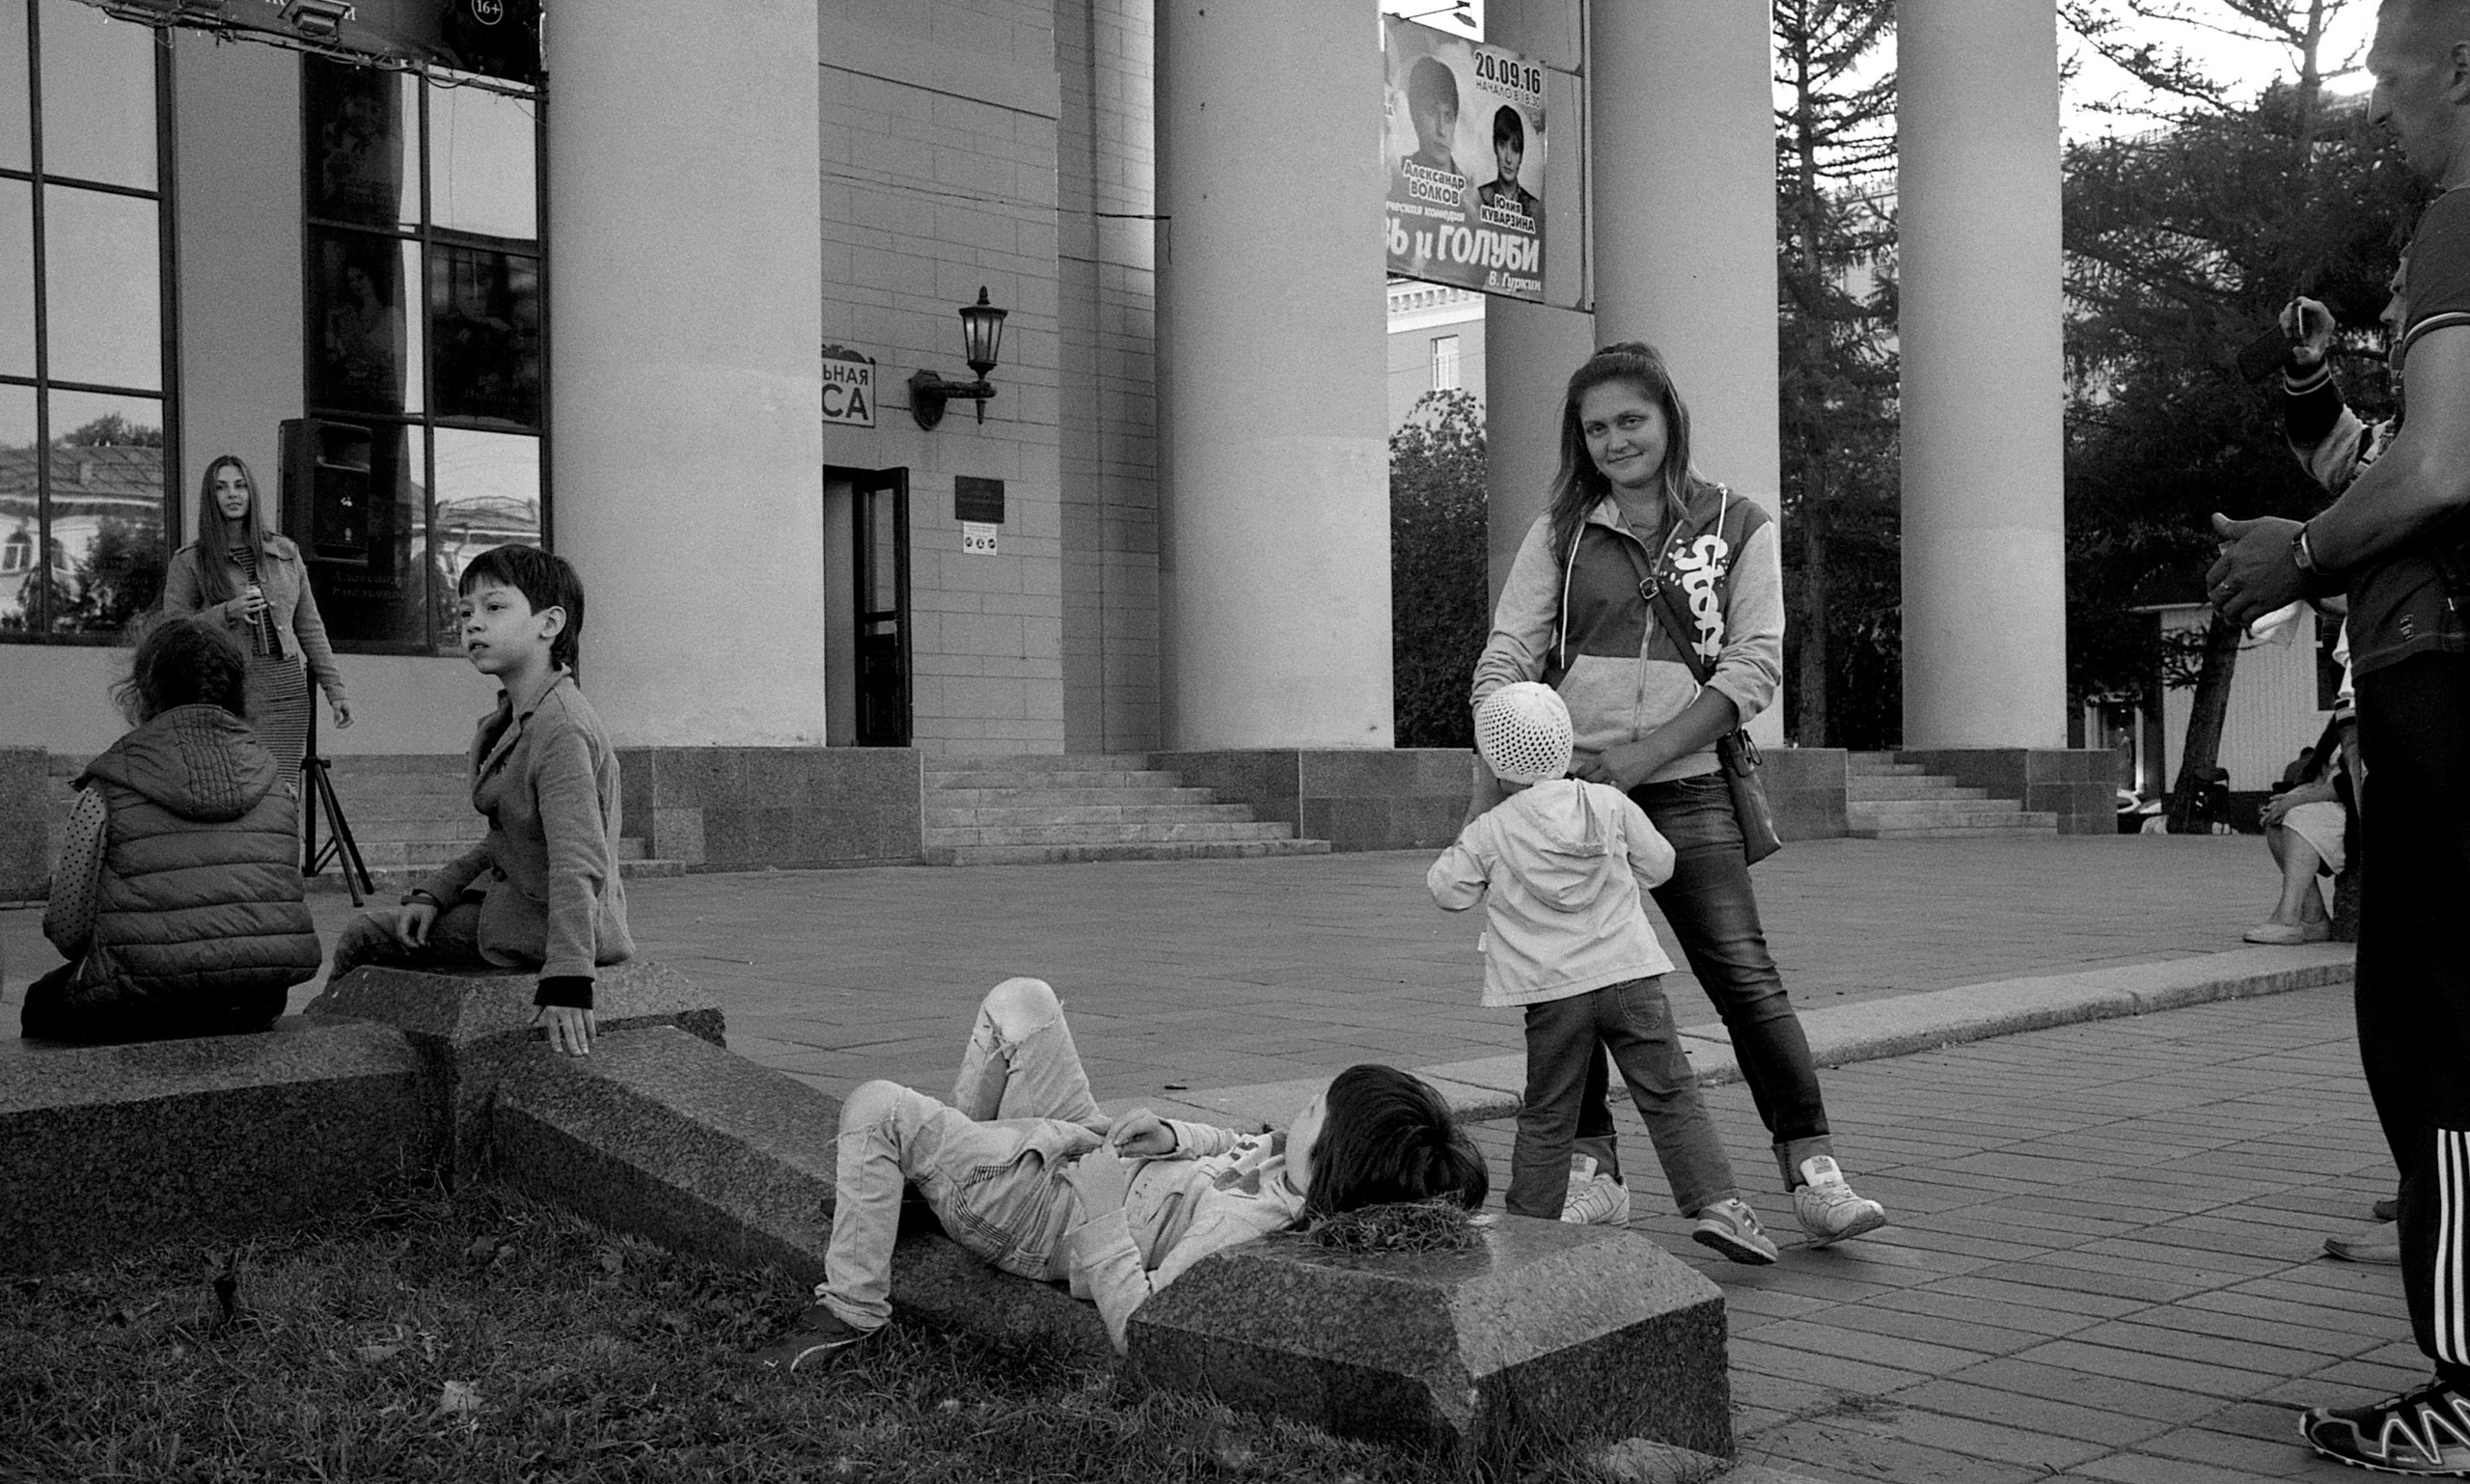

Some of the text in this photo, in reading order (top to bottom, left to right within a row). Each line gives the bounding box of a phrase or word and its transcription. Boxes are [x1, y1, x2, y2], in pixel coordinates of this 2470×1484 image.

[477, 0, 501, 14] 16+
[1475, 51, 1541, 95] 20.09.16
[1475, 80, 1512, 98] НАЧАЛО
[1411, 180, 1460, 206] ВОЛКОВ
[1481, 206, 1535, 233] КУВАРЗИНА
[1438, 225, 1540, 273] ГОЛУБИ
[823, 364, 868, 386] ЬНАЯ
[822, 383, 869, 421] СА
